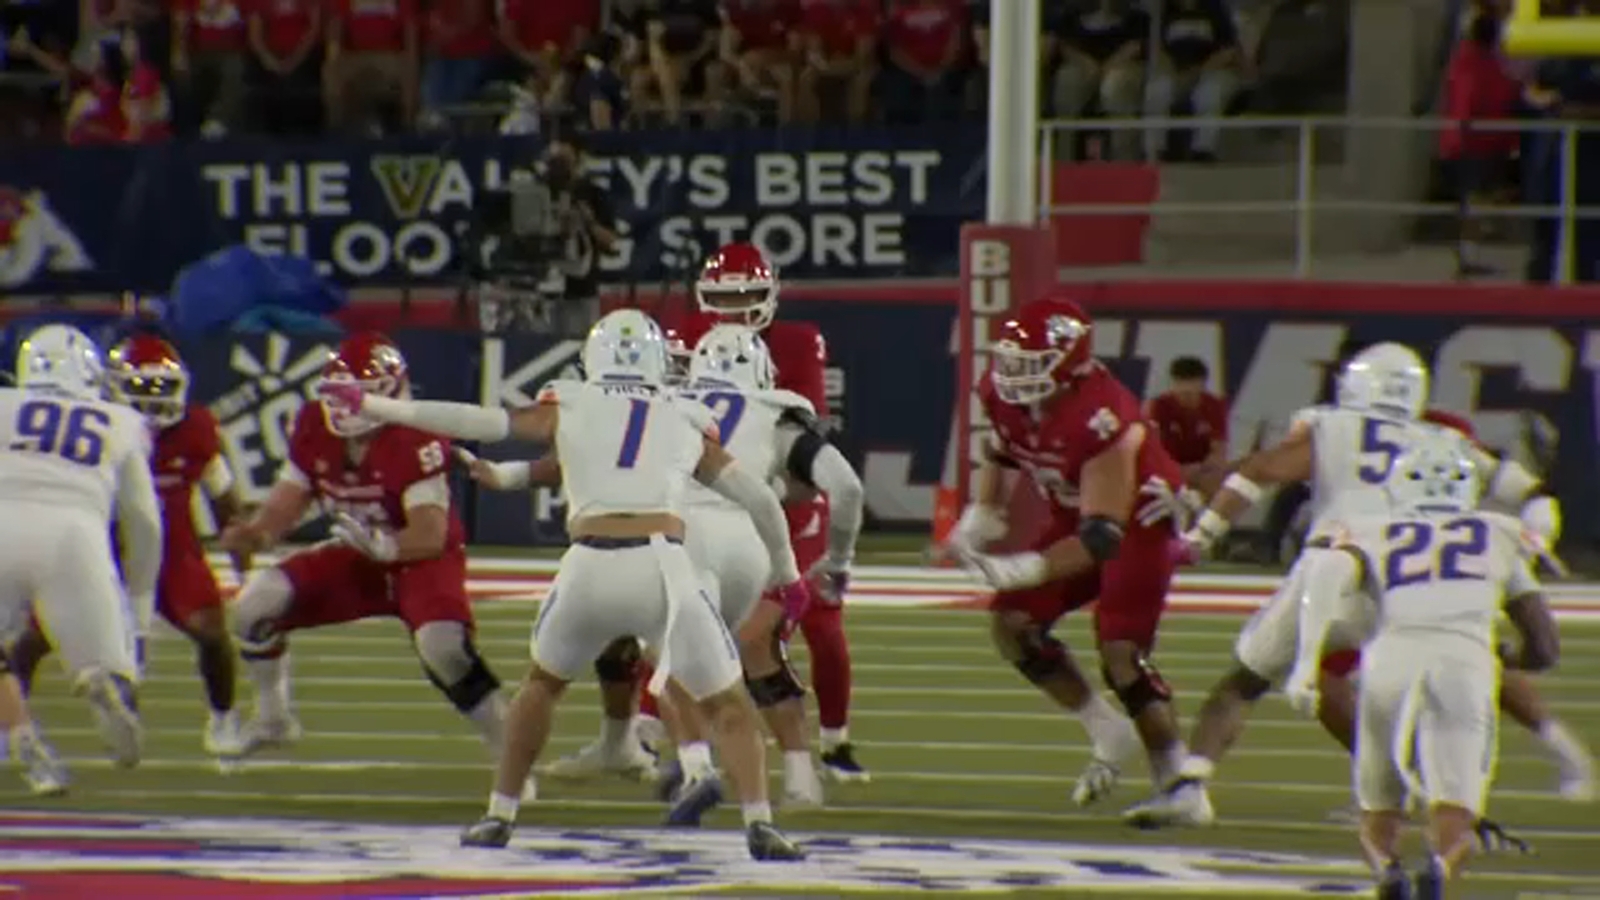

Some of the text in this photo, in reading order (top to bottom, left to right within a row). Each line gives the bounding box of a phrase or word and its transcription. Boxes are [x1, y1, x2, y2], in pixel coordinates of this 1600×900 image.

[203, 161, 350, 217] THE
[755, 151, 941, 207] BEST
[659, 213, 904, 267] STORE
[17, 401, 110, 467] 96
[616, 398, 650, 469] 1
[1359, 416, 1406, 485] 5
[1386, 518, 1489, 590] 22
